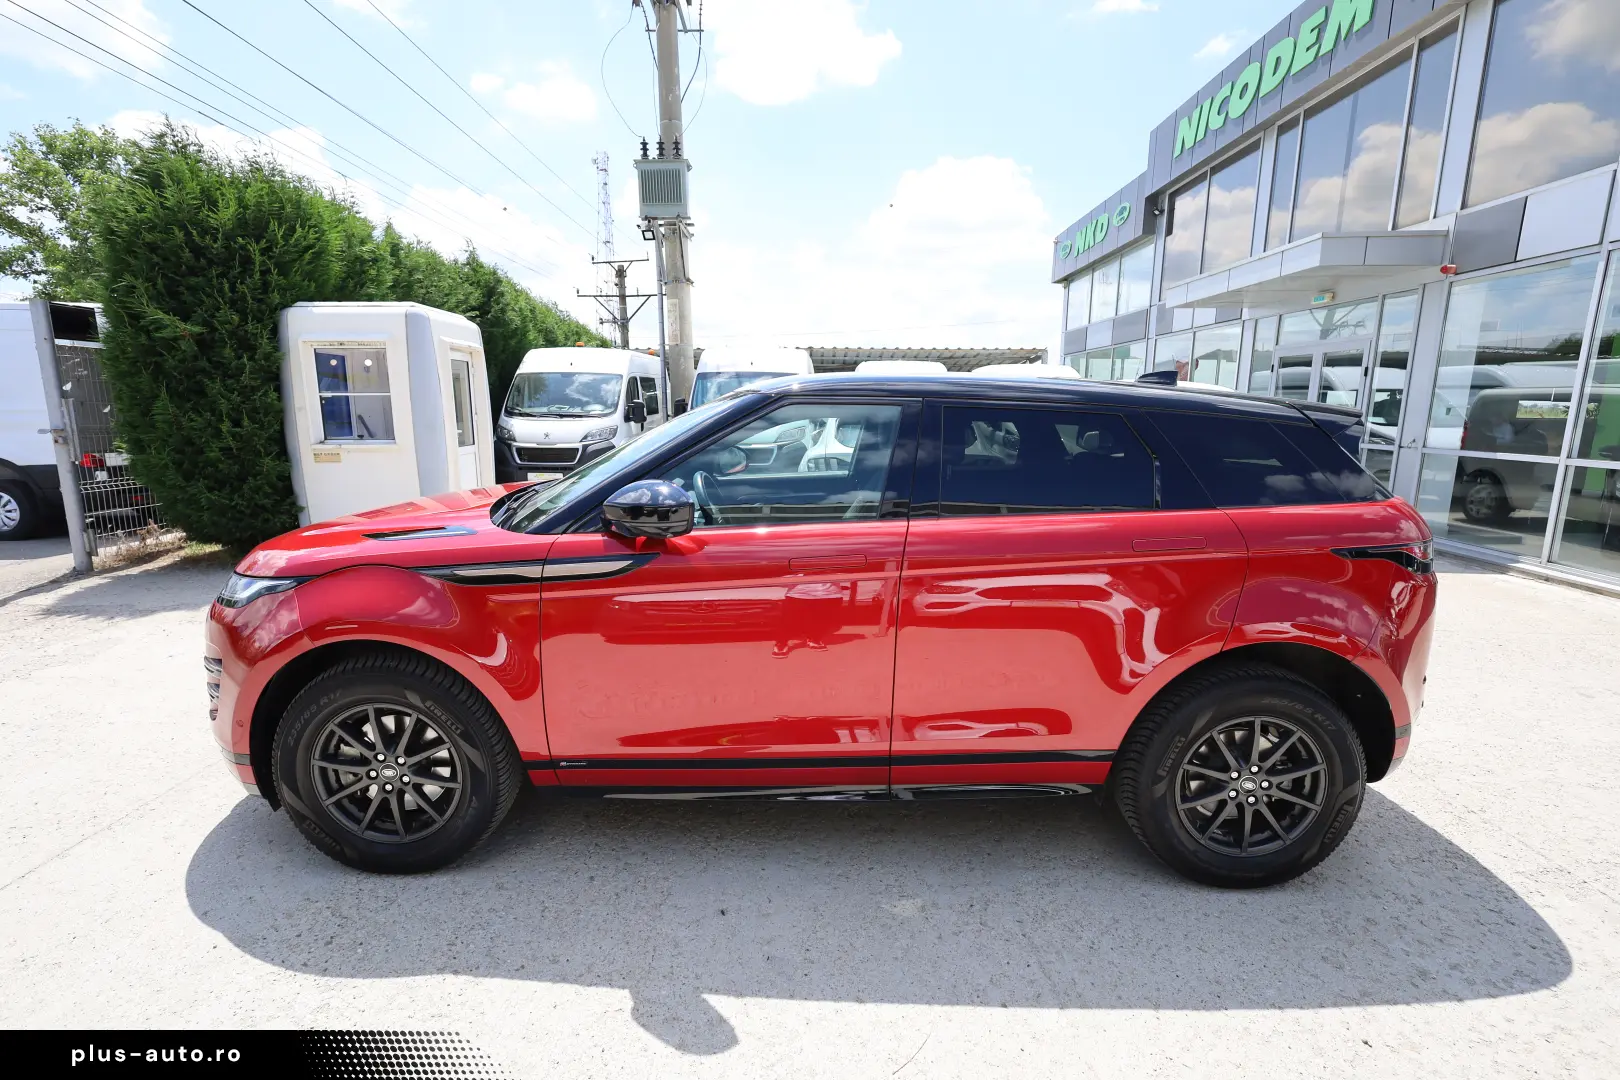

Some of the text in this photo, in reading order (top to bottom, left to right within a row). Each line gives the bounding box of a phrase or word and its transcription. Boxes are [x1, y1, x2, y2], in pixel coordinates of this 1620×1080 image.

[1173, 0, 1374, 160] NICODEM
[1074, 213, 1109, 258] NKD
[424, 700, 464, 735] PIRELLI
[1156, 735, 1186, 777] PIRELLI
